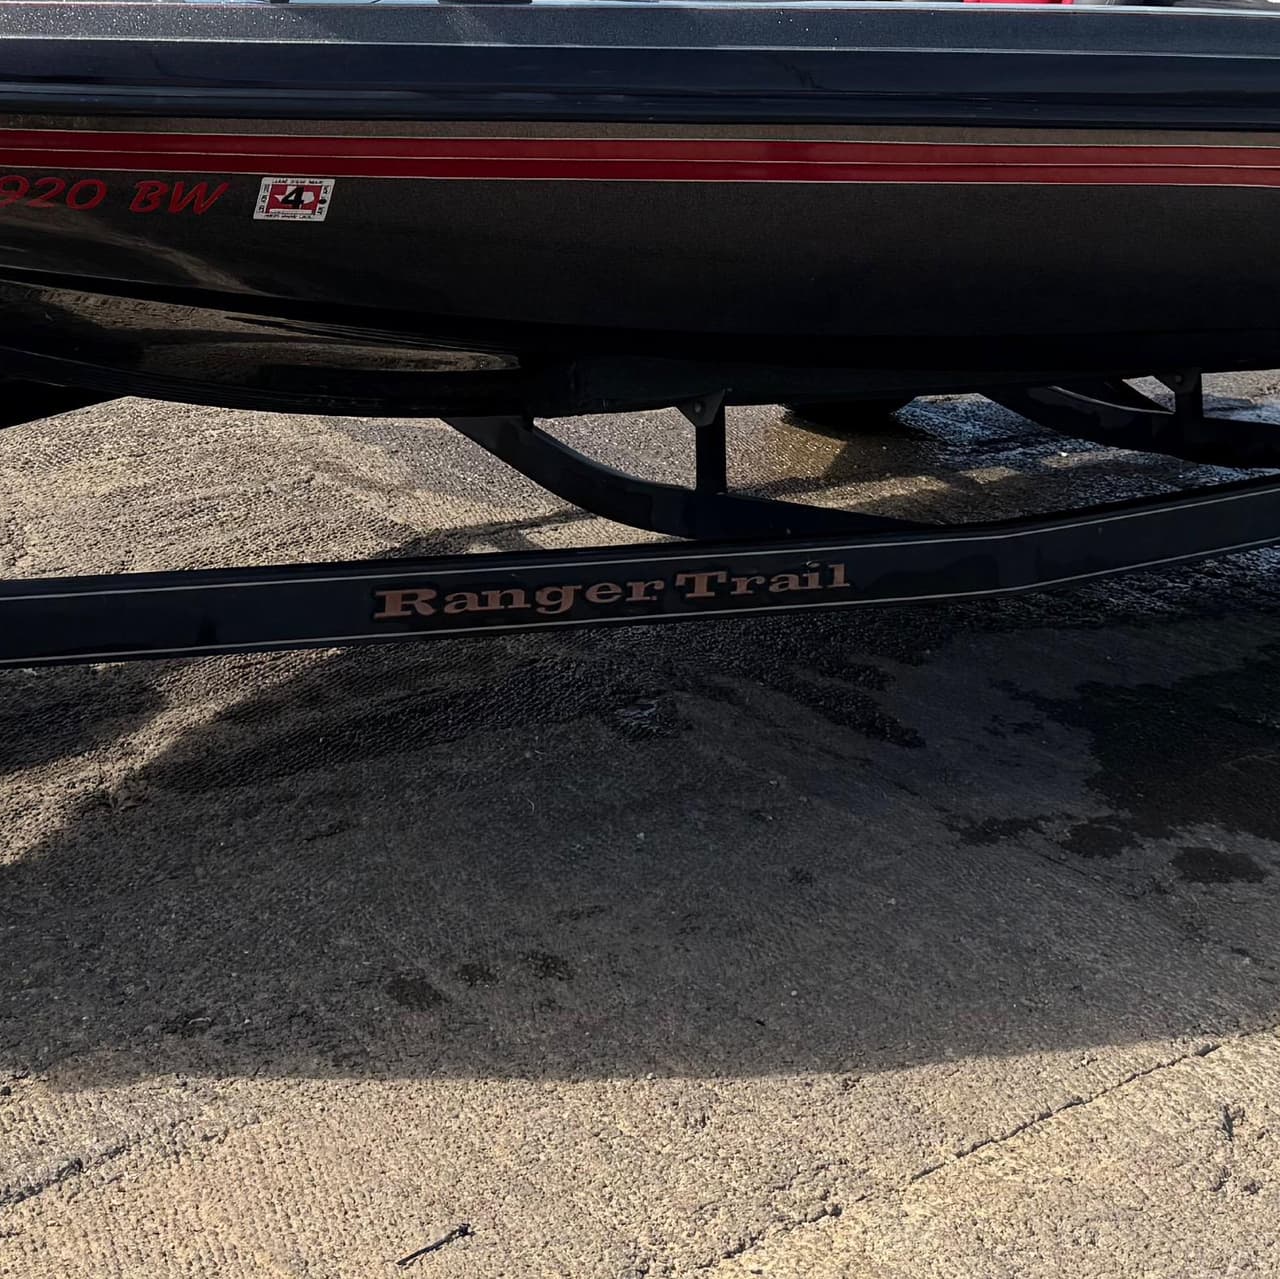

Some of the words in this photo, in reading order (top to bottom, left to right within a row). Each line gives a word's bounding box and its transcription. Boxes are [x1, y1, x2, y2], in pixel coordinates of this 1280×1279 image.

[129, 179, 230, 215] BW
[373, 580, 665, 619] Ranger
[674, 562, 851, 599] Trail
